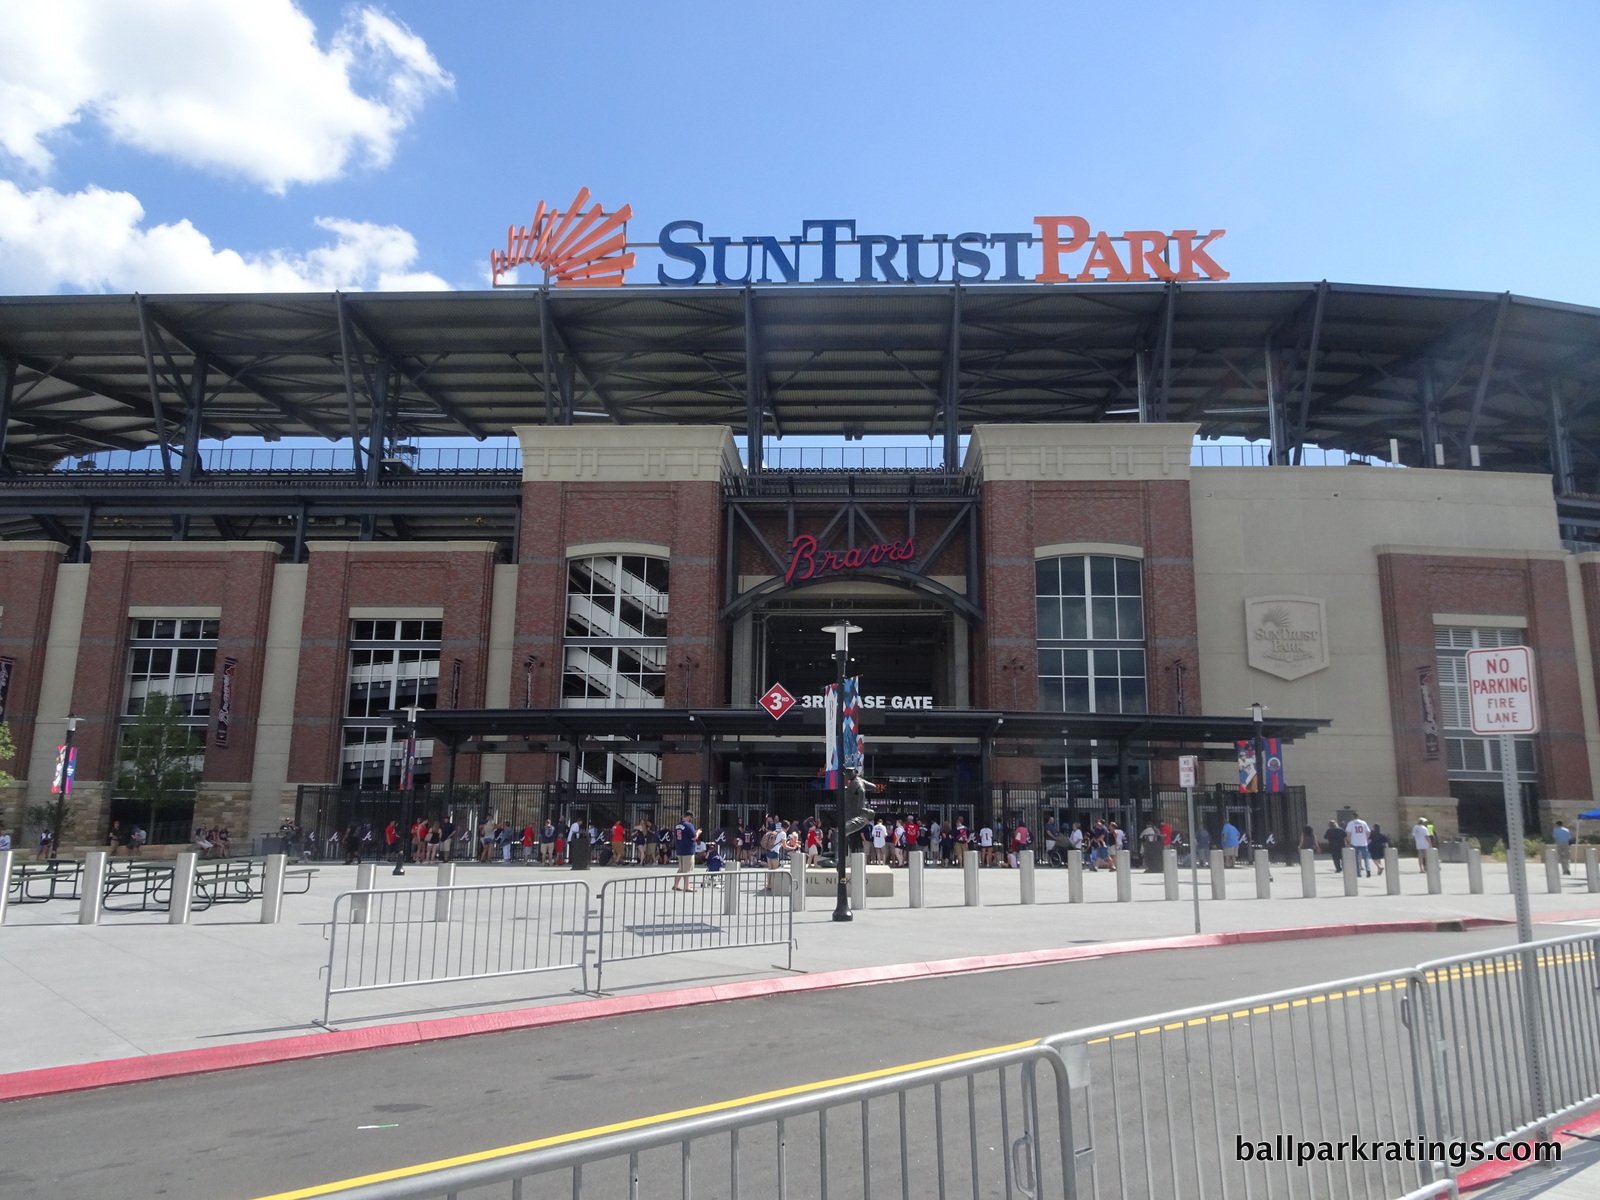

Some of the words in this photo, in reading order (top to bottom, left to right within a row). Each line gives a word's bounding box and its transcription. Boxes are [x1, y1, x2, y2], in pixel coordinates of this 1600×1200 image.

[1033, 216, 1230, 282] PARK
[785, 535, 915, 583] Braves
[1272, 640, 1305, 653] PARK
[1486, 658, 1509, 674] NO
[1473, 677, 1527, 694] PARKING
[891, 696, 933, 709] GATE
[1487, 697, 1515, 708] FIRE
[1486, 712, 1518, 723] LANE
